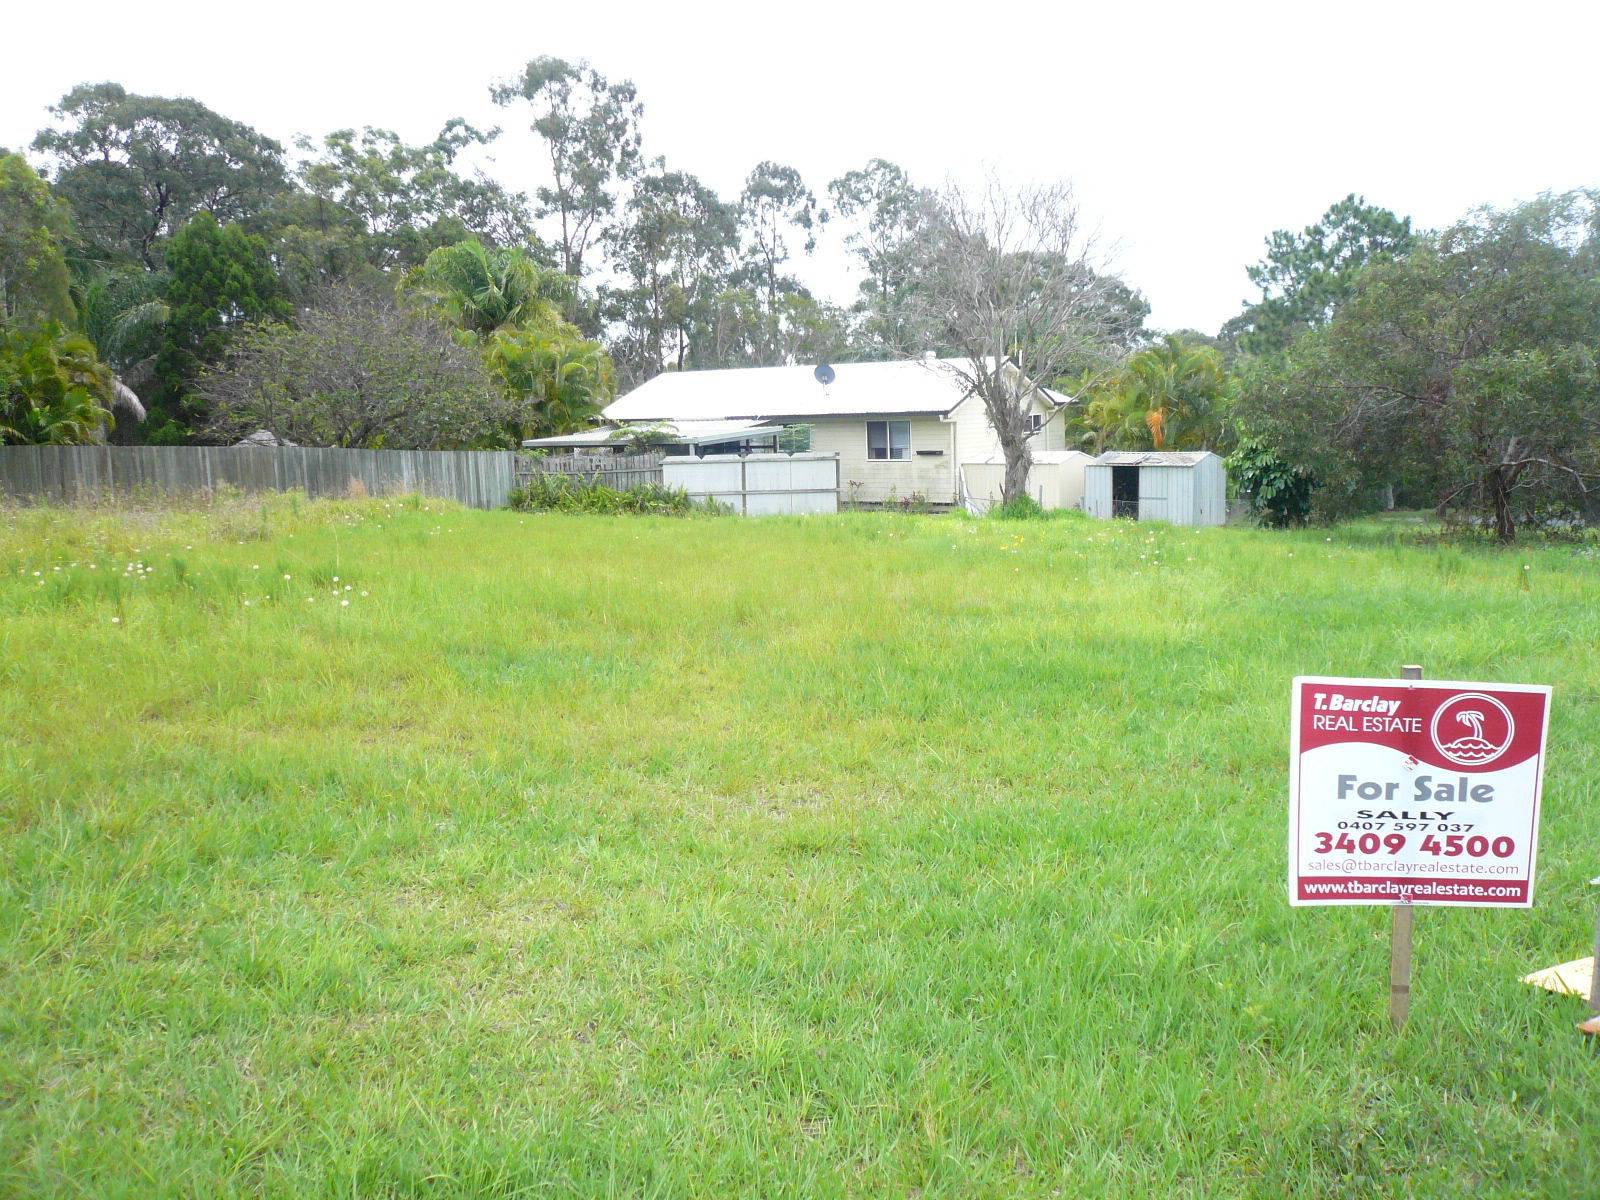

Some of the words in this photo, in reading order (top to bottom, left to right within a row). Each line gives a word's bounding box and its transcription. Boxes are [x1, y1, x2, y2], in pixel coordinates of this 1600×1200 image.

[1314, 715, 1360, 731] REAL
[1363, 717, 1422, 732] ESTATE
[1337, 774, 1400, 800] For
[1414, 775, 1494, 802] Sale
[1357, 810, 1455, 820] SALLY
[1337, 822, 1384, 830] 0407
[1394, 822, 1430, 831] 597
[1438, 823, 1474, 832] 037
[1314, 832, 1406, 854] 3409
[1420, 835, 1515, 858] 4500
[1308, 859, 1518, 875] sales@tbarclayrealestate.com
[1304, 881, 1521, 897] www.tbarclayrealestate.com
